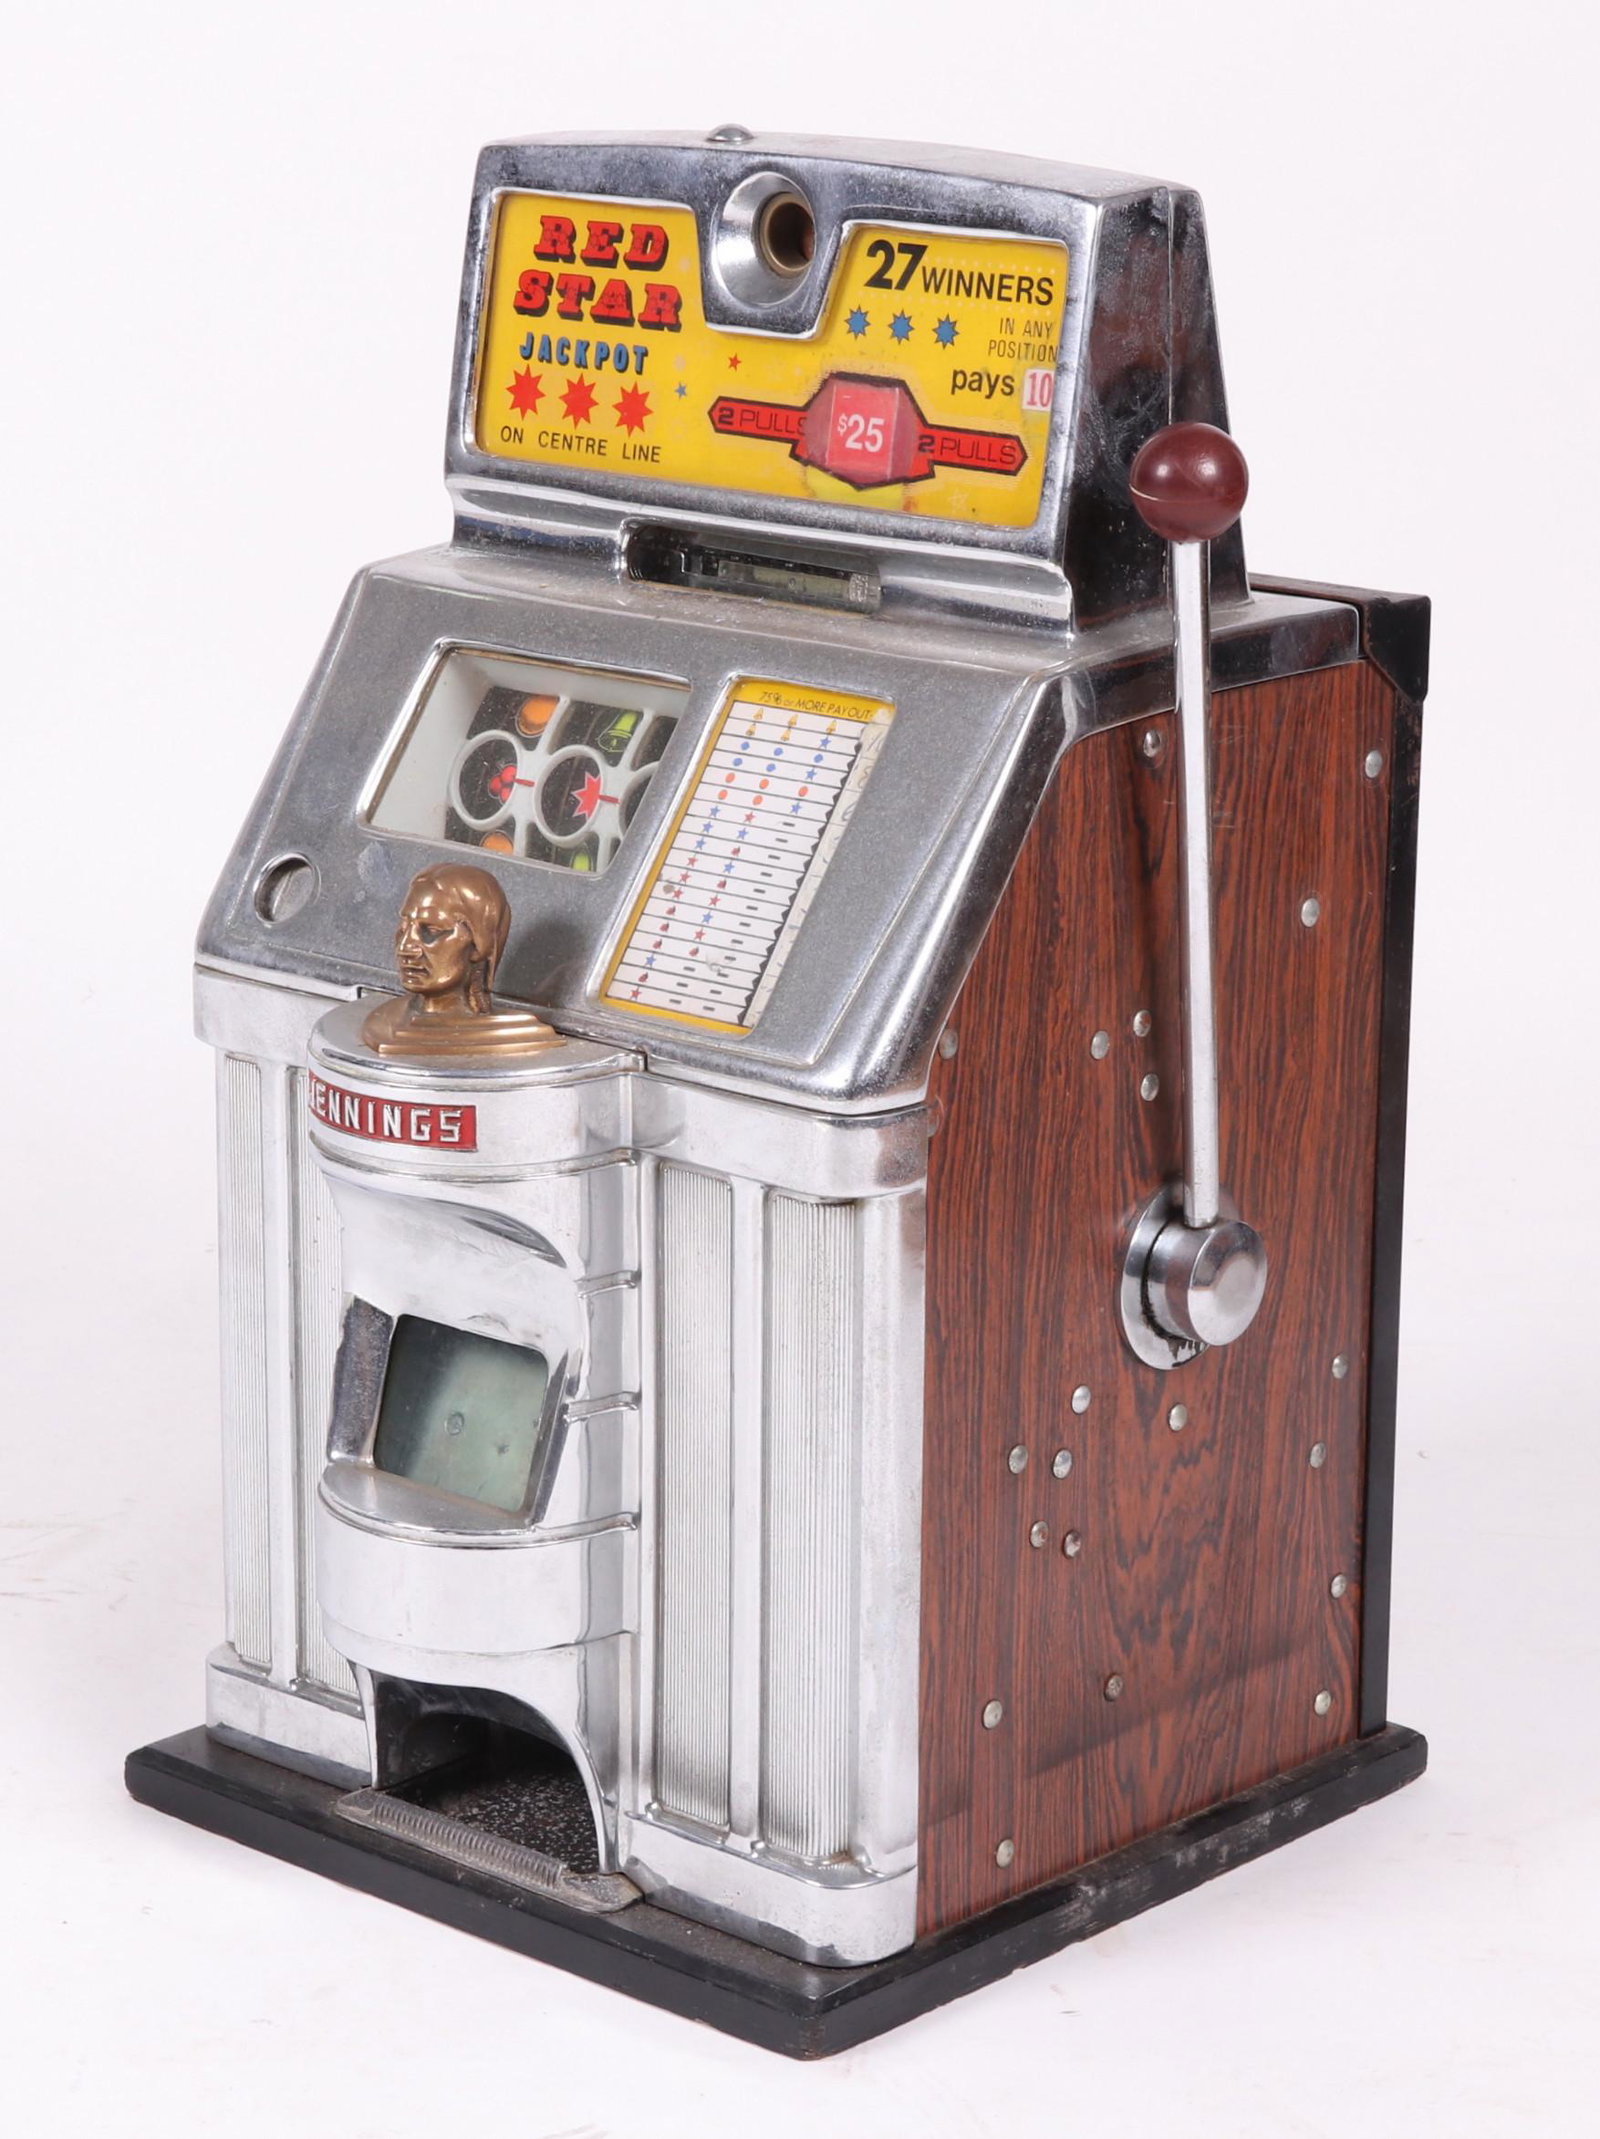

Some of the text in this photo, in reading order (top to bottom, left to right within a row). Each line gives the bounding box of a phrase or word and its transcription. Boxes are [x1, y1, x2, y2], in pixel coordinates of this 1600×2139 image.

[533, 215, 669, 272] RED
[864, 239, 1054, 306] 27 WINNERS
[513, 269, 682, 333] STAR
[999, 317, 1054, 340] IN ANY
[519, 332, 648, 375] JACKPOT
[988, 339, 1058, 362] POSITION
[951, 368, 1054, 407] pays 10
[718, 407, 735, 426] 2
[837, 413, 885, 453] $25
[500, 425, 661, 463] ON CENTRE LINE
[918, 435, 1017, 466] 2 PULLS
[795, 698, 828, 713] MORE
